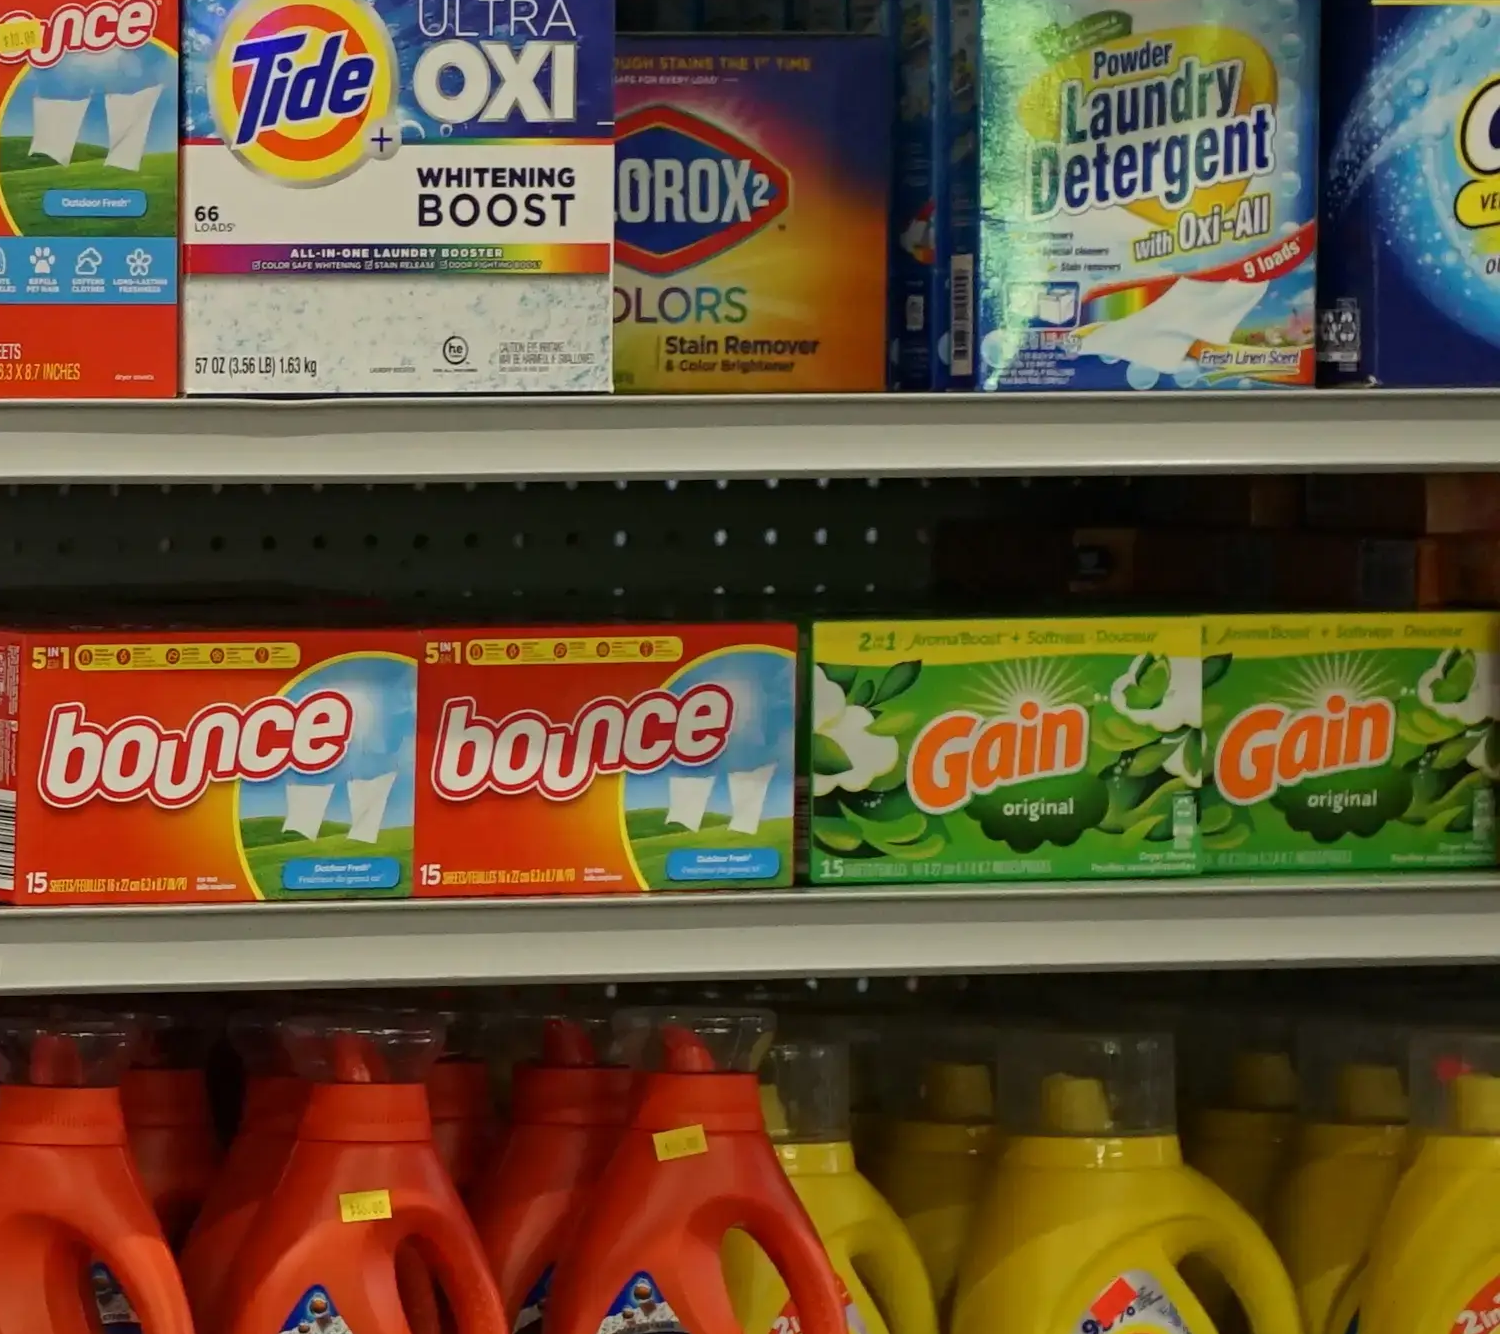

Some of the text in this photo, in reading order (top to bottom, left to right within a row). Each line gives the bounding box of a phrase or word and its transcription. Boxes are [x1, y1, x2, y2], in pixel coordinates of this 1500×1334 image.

[1093, 40, 1173, 81] Powder
[231, 32, 375, 153] Tide
[412, 39, 578, 124] OXI
[1065, 62, 1240, 145] Laundry
[417, 167, 576, 188] WHITENING
[1030, 109, 1272, 217] Detergent
[194, 205, 219, 223] 66
[418, 193, 575, 228] BOOST
[290, 248, 504, 258] ALL-IN-ONE LAUNDRY BOOSTER
[1134, 236, 1174, 261] with
[665, 335, 821, 355] Stain Remover
[194, 356, 317, 378] 57 OZ (3.56 LB) 1.63 kg
[40, 691, 352, 808] bounce
[433, 685, 732, 800] bounce
[908, 701, 1087, 814] Gain
[1216, 695, 1394, 804] Gain
[1003, 798, 1074, 823] original
[1307, 789, 1378, 813] original
[26, 872, 48, 894] 15
[420, 864, 441, 885] 15
